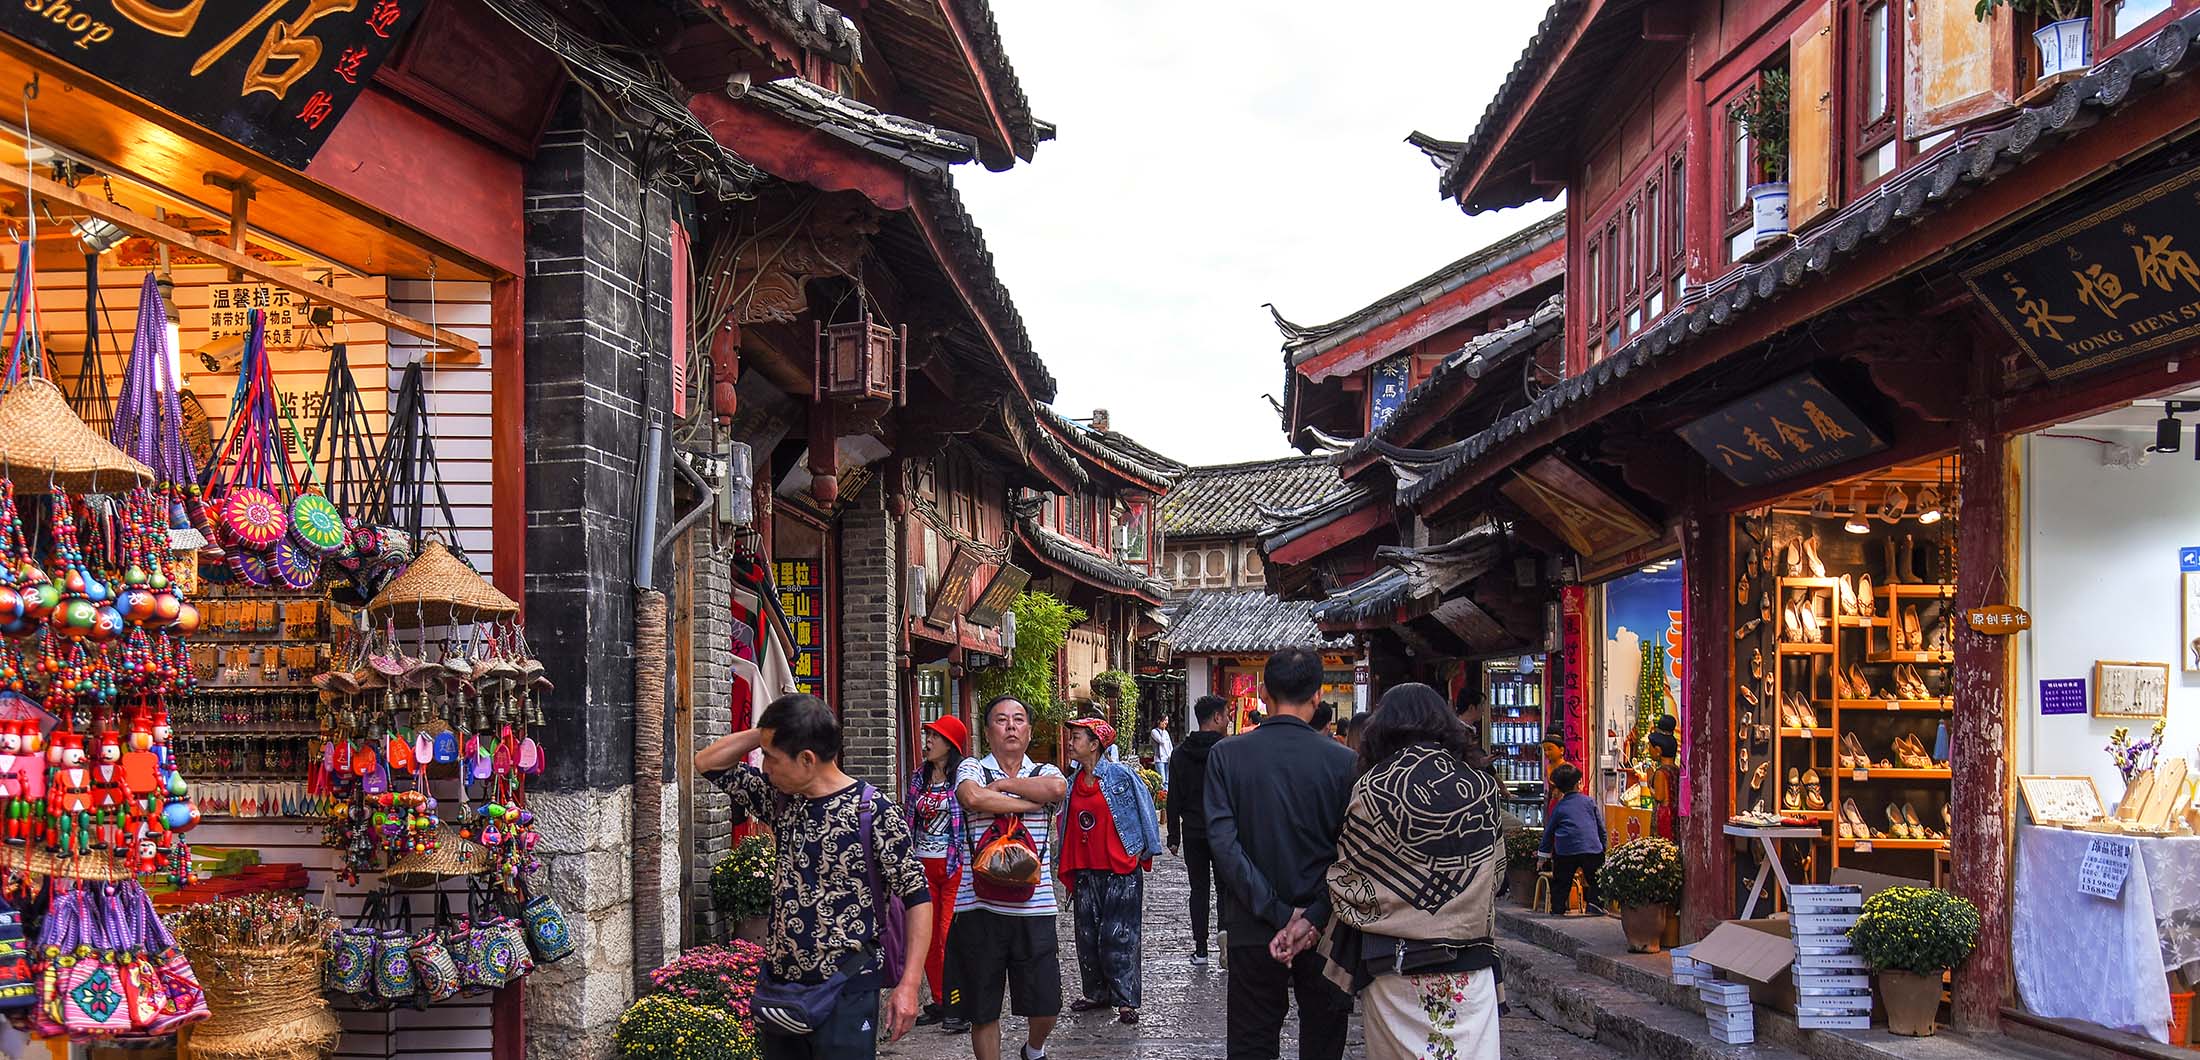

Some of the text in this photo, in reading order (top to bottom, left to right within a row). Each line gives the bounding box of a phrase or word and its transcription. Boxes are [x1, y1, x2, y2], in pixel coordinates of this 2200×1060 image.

[213, 287, 290, 309] 温馨提示
[211, 310, 291, 327] 请带好物品
[2066, 328, 2125, 356] YONG
[2128, 310, 2179, 337] HEN
[1972, 613, 2028, 626] 原创手作
